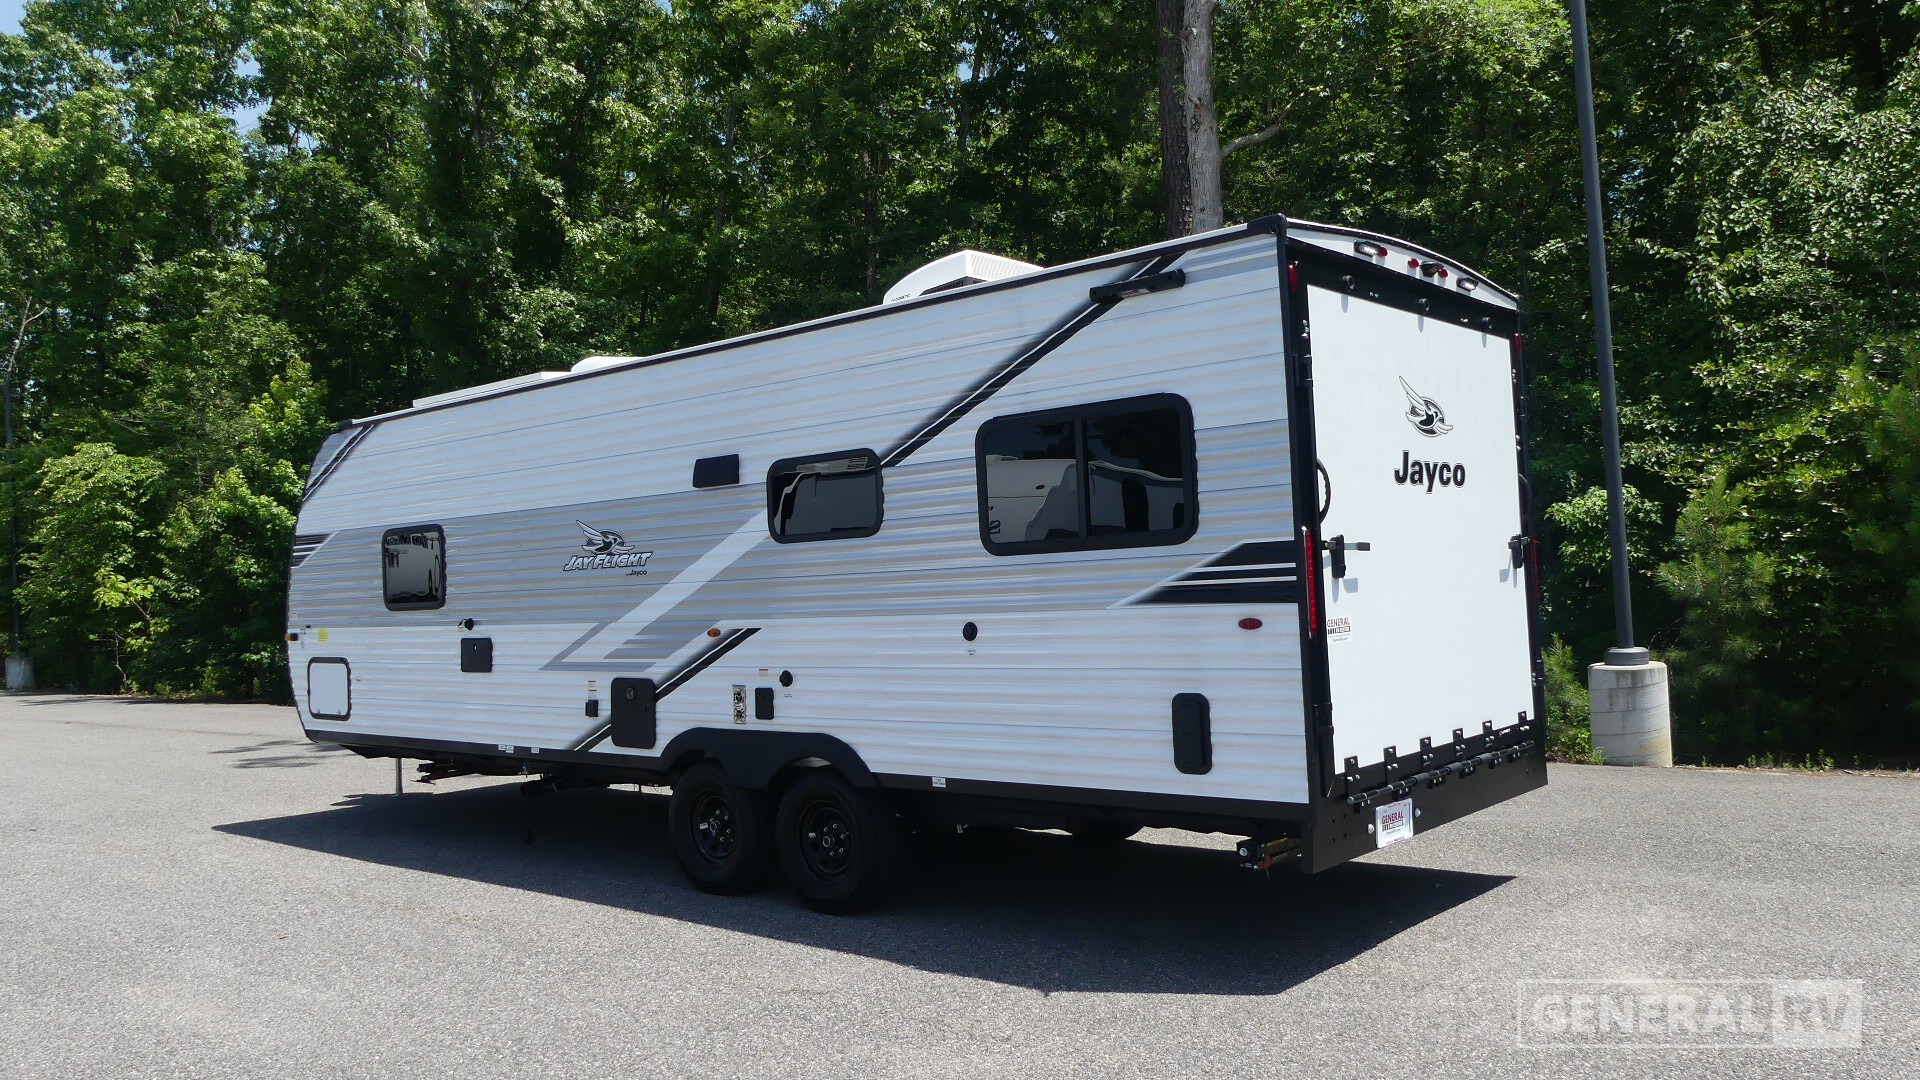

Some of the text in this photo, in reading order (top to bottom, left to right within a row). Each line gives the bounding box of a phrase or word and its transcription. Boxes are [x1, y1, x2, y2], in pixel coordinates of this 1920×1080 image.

[1394, 449, 1466, 494] Jayco
[563, 551, 654, 571] JAY FLIGHT
[1326, 617, 1350, 627] GENERAL
[1382, 811, 1404, 824] GENERAL
